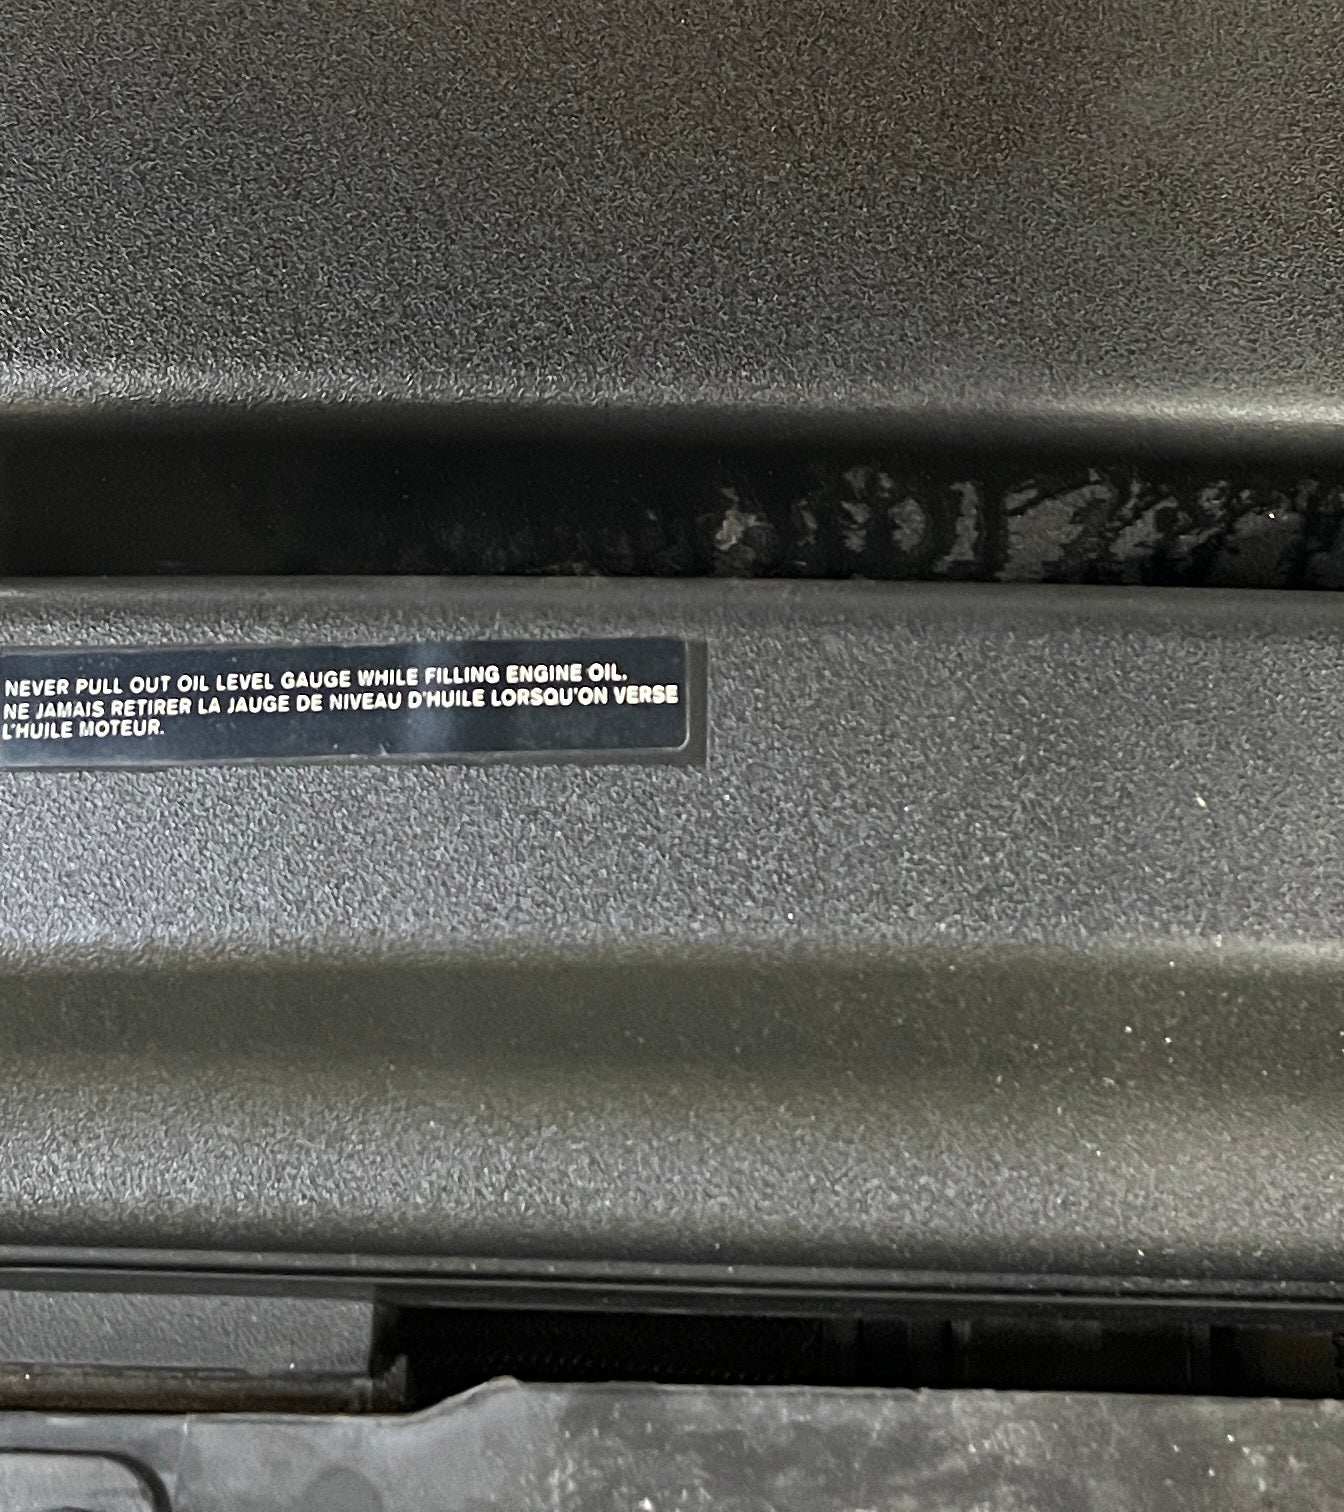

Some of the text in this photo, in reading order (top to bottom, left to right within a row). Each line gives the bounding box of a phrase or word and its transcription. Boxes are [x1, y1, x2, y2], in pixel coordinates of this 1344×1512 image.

[4, 662, 628, 697] NEVER PULL OUT OIL LEVEL GAUGE WHILE FILLING ENGINE OIL.
[3, 684, 679, 720] NE JAMAIS RETIRER LA JAUGE DE NIVEAU D'HUILE LORSQU'ON VERSE
[2, 718, 166, 740] L'HUILE MOTEUR.
